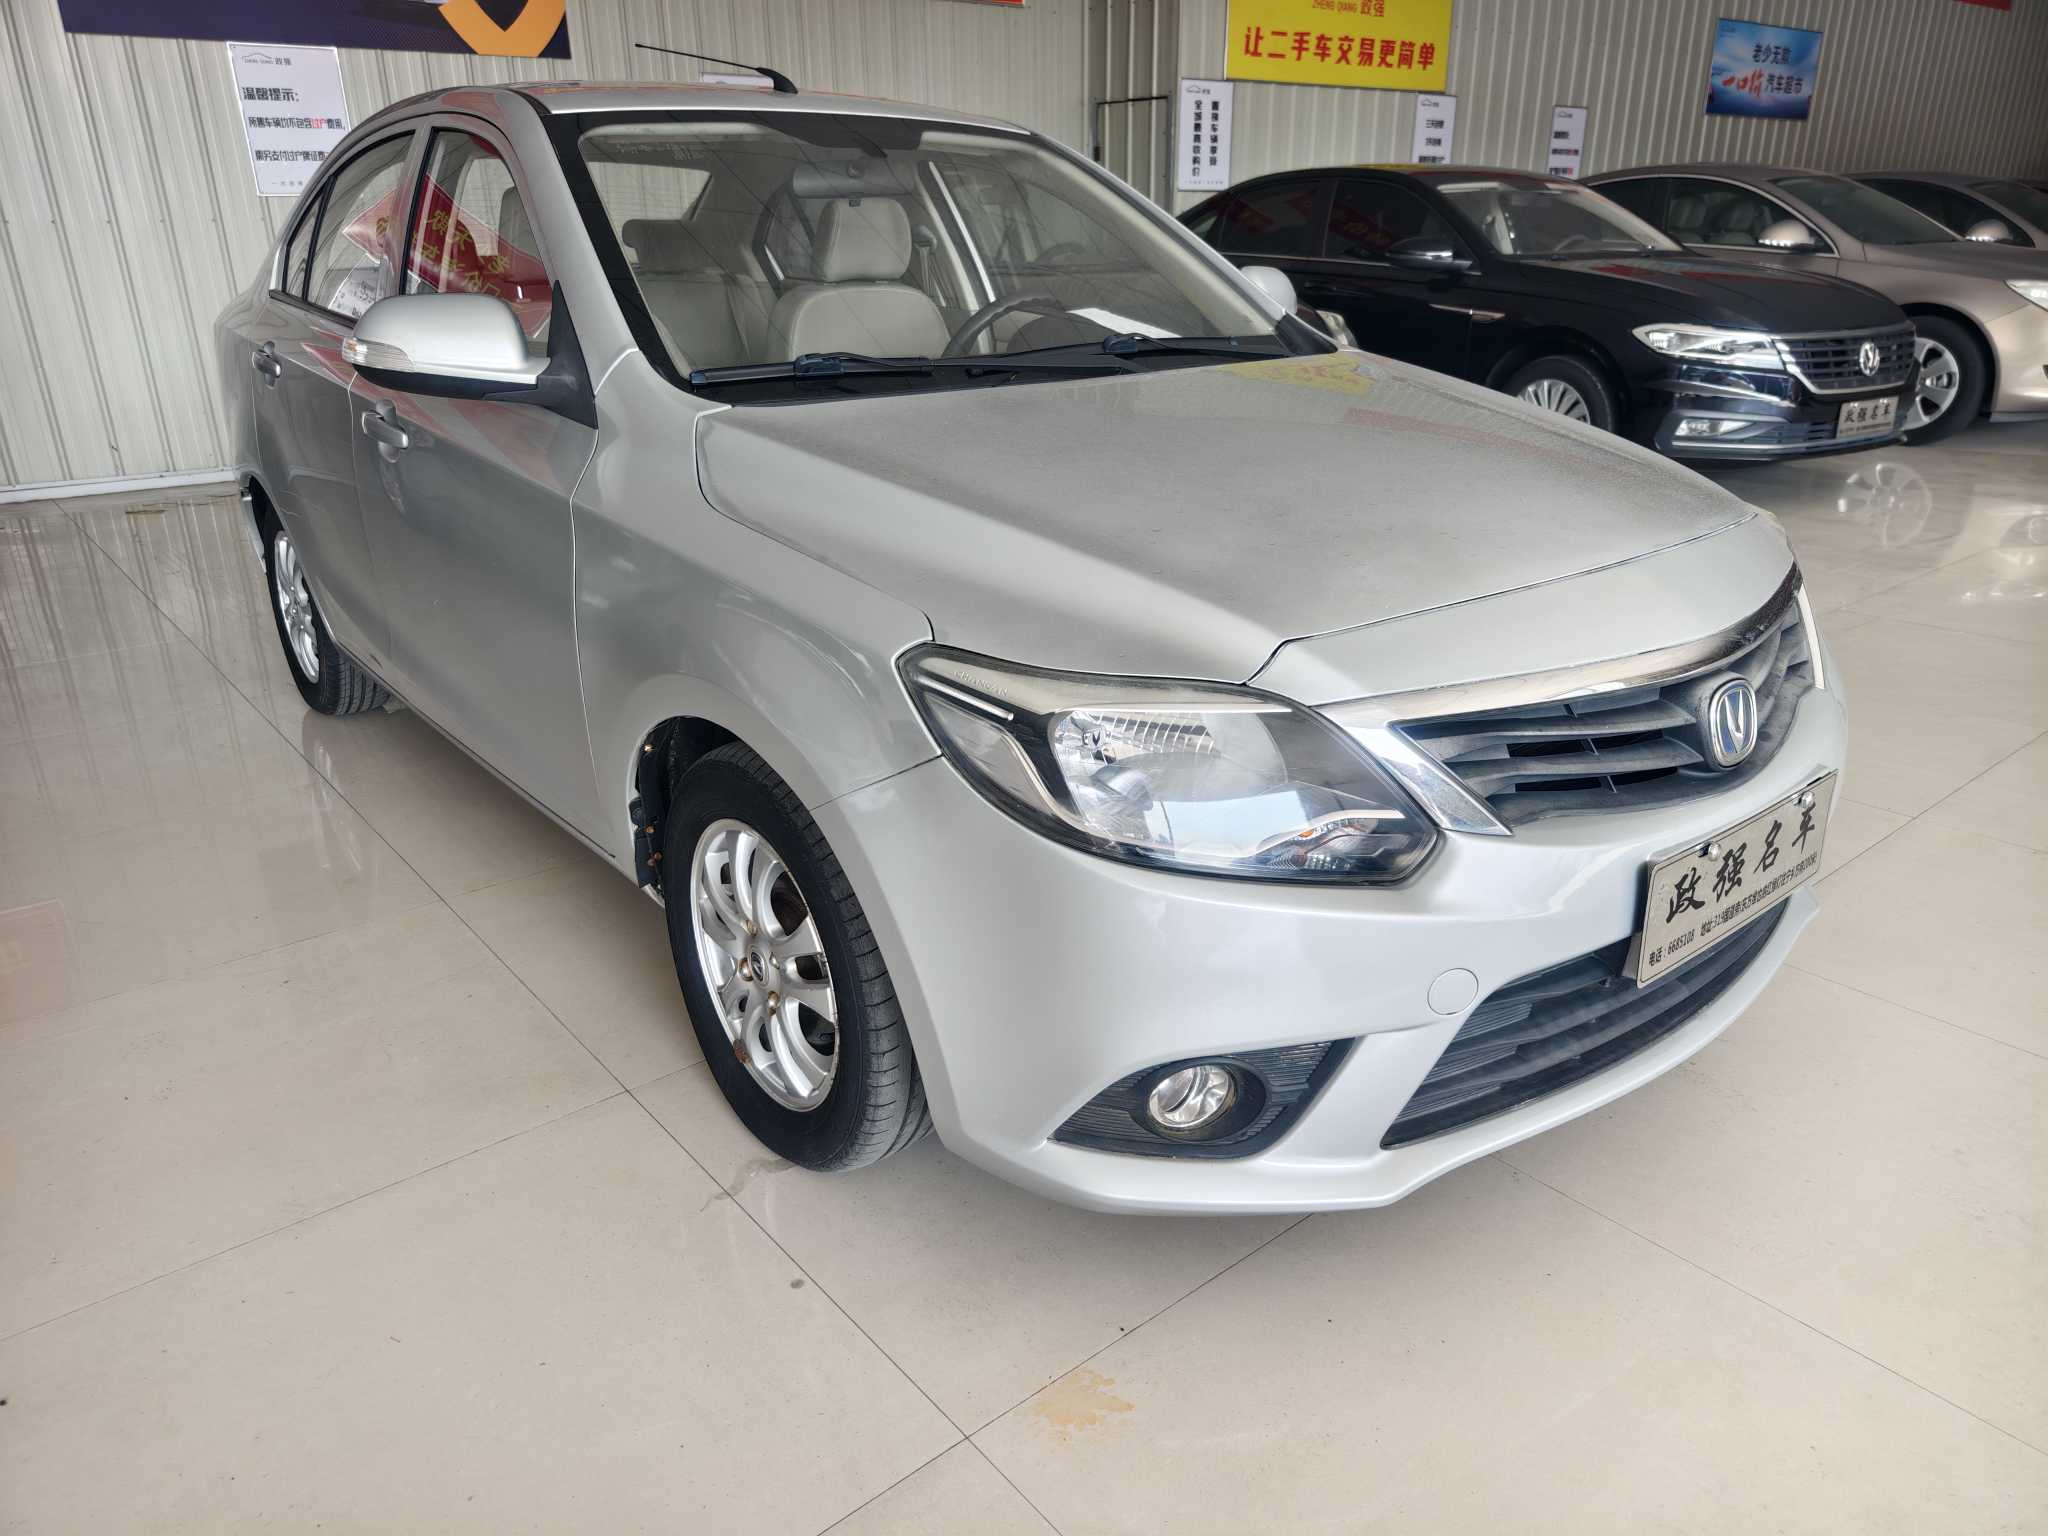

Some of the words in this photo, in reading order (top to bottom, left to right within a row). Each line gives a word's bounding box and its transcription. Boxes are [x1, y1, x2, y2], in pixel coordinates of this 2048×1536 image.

[1244, 26, 1436, 71] 让二手车交易更简单
[1666, 802, 1816, 925] 政强名车
